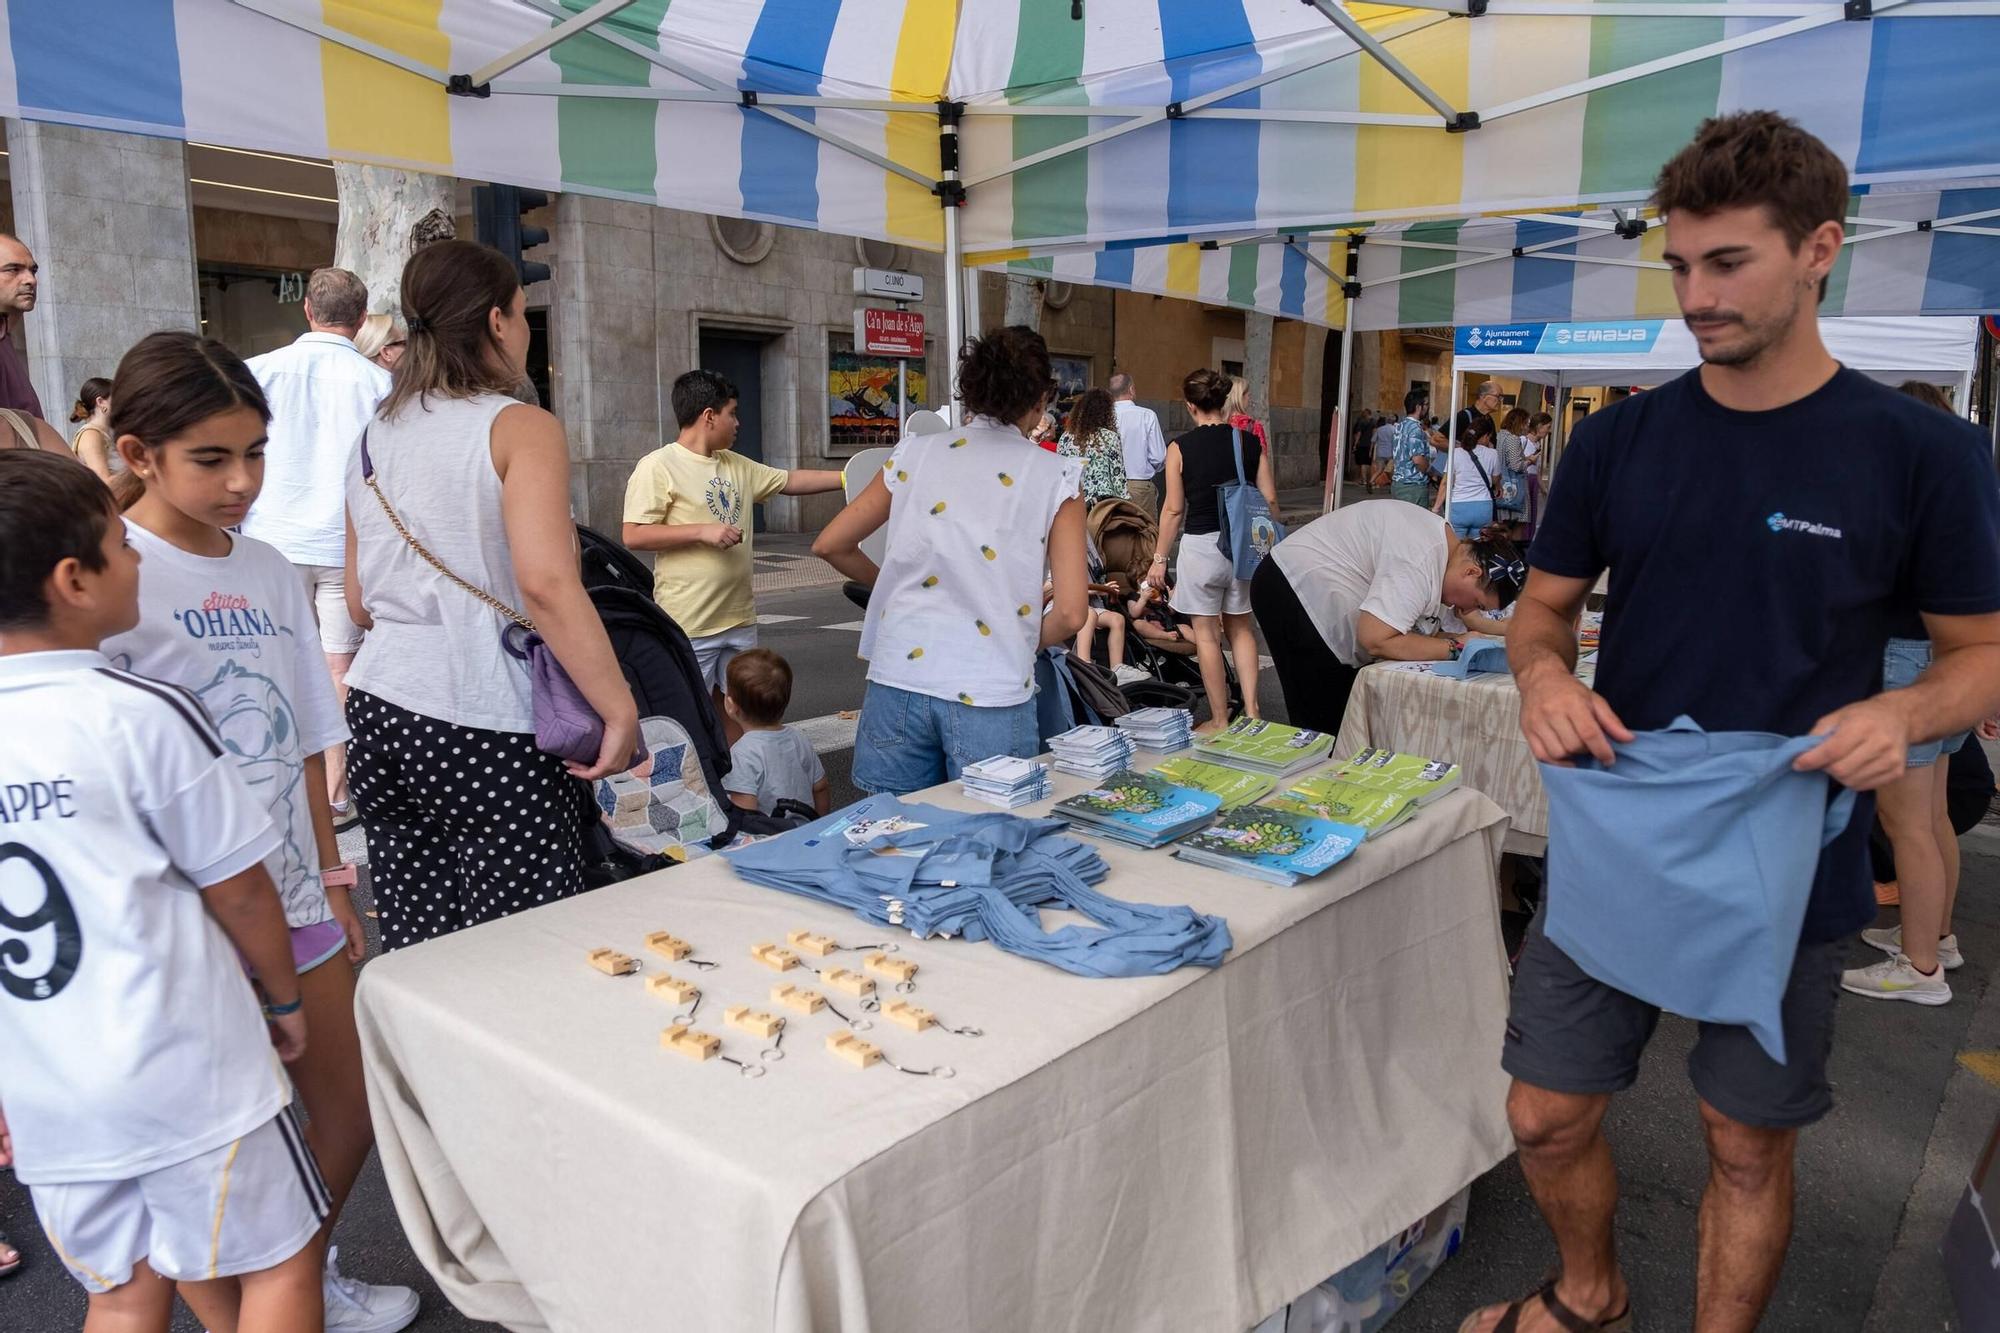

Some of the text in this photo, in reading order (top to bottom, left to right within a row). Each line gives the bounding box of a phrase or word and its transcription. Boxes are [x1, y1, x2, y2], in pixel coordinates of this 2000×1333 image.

[881, 312, 895, 333] Joan
[896, 313, 903, 332] de
[1484, 338, 1523, 347] de Palma
[1485, 329, 1530, 339] Ajuntament
[202, 591, 251, 610] Stitch
[0, 841, 82, 1001] 9
